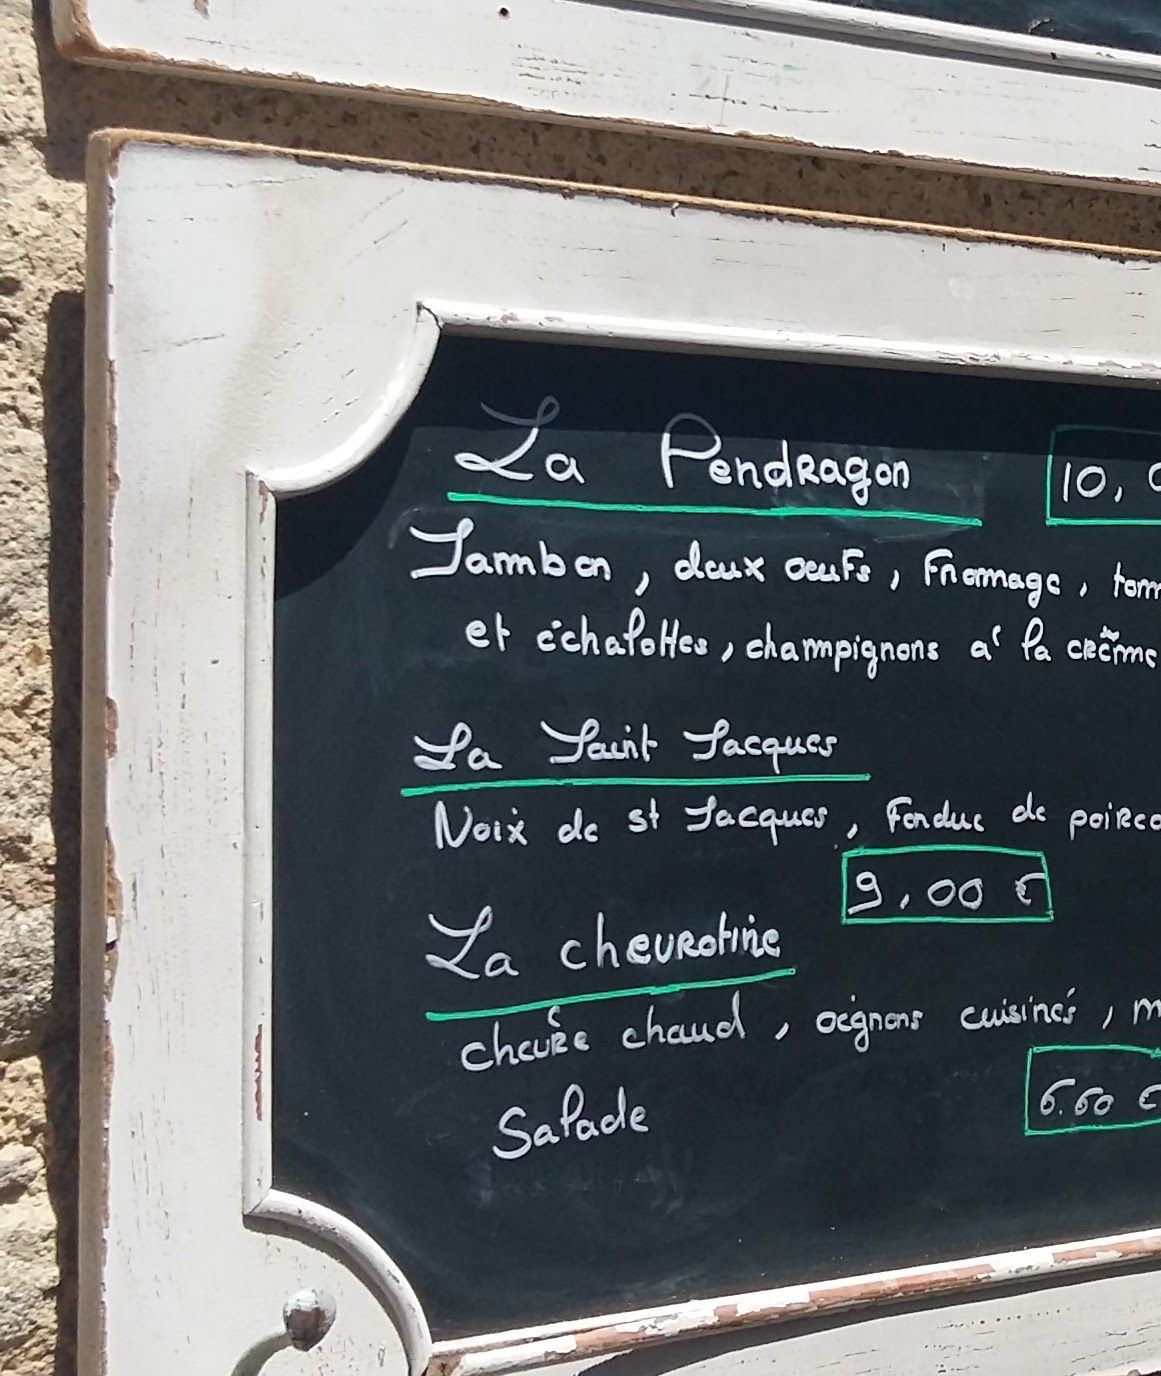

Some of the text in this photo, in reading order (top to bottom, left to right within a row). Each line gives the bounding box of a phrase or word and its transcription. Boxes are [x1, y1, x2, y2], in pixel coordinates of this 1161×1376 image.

[453, 395, 912, 506] La Pendragon
[674, 538, 767, 583] deux
[465, 611, 512, 654] et
[745, 621, 941, 681] champignons
[1020, 616, 1053, 664] la
[413, 720, 504, 772] La
[682, 717, 840, 776] Jacques
[433, 798, 530, 851] Noix
[557, 806, 600, 845] de
[685, 794, 830, 847] Jacques
[1011, 790, 1049, 824] de
[425, 904, 782, 981] La chevrotine
[621, 990, 748, 1052] chaud
[815, 994, 926, 1054] oignons
[491, 1082, 650, 1161] Salade
